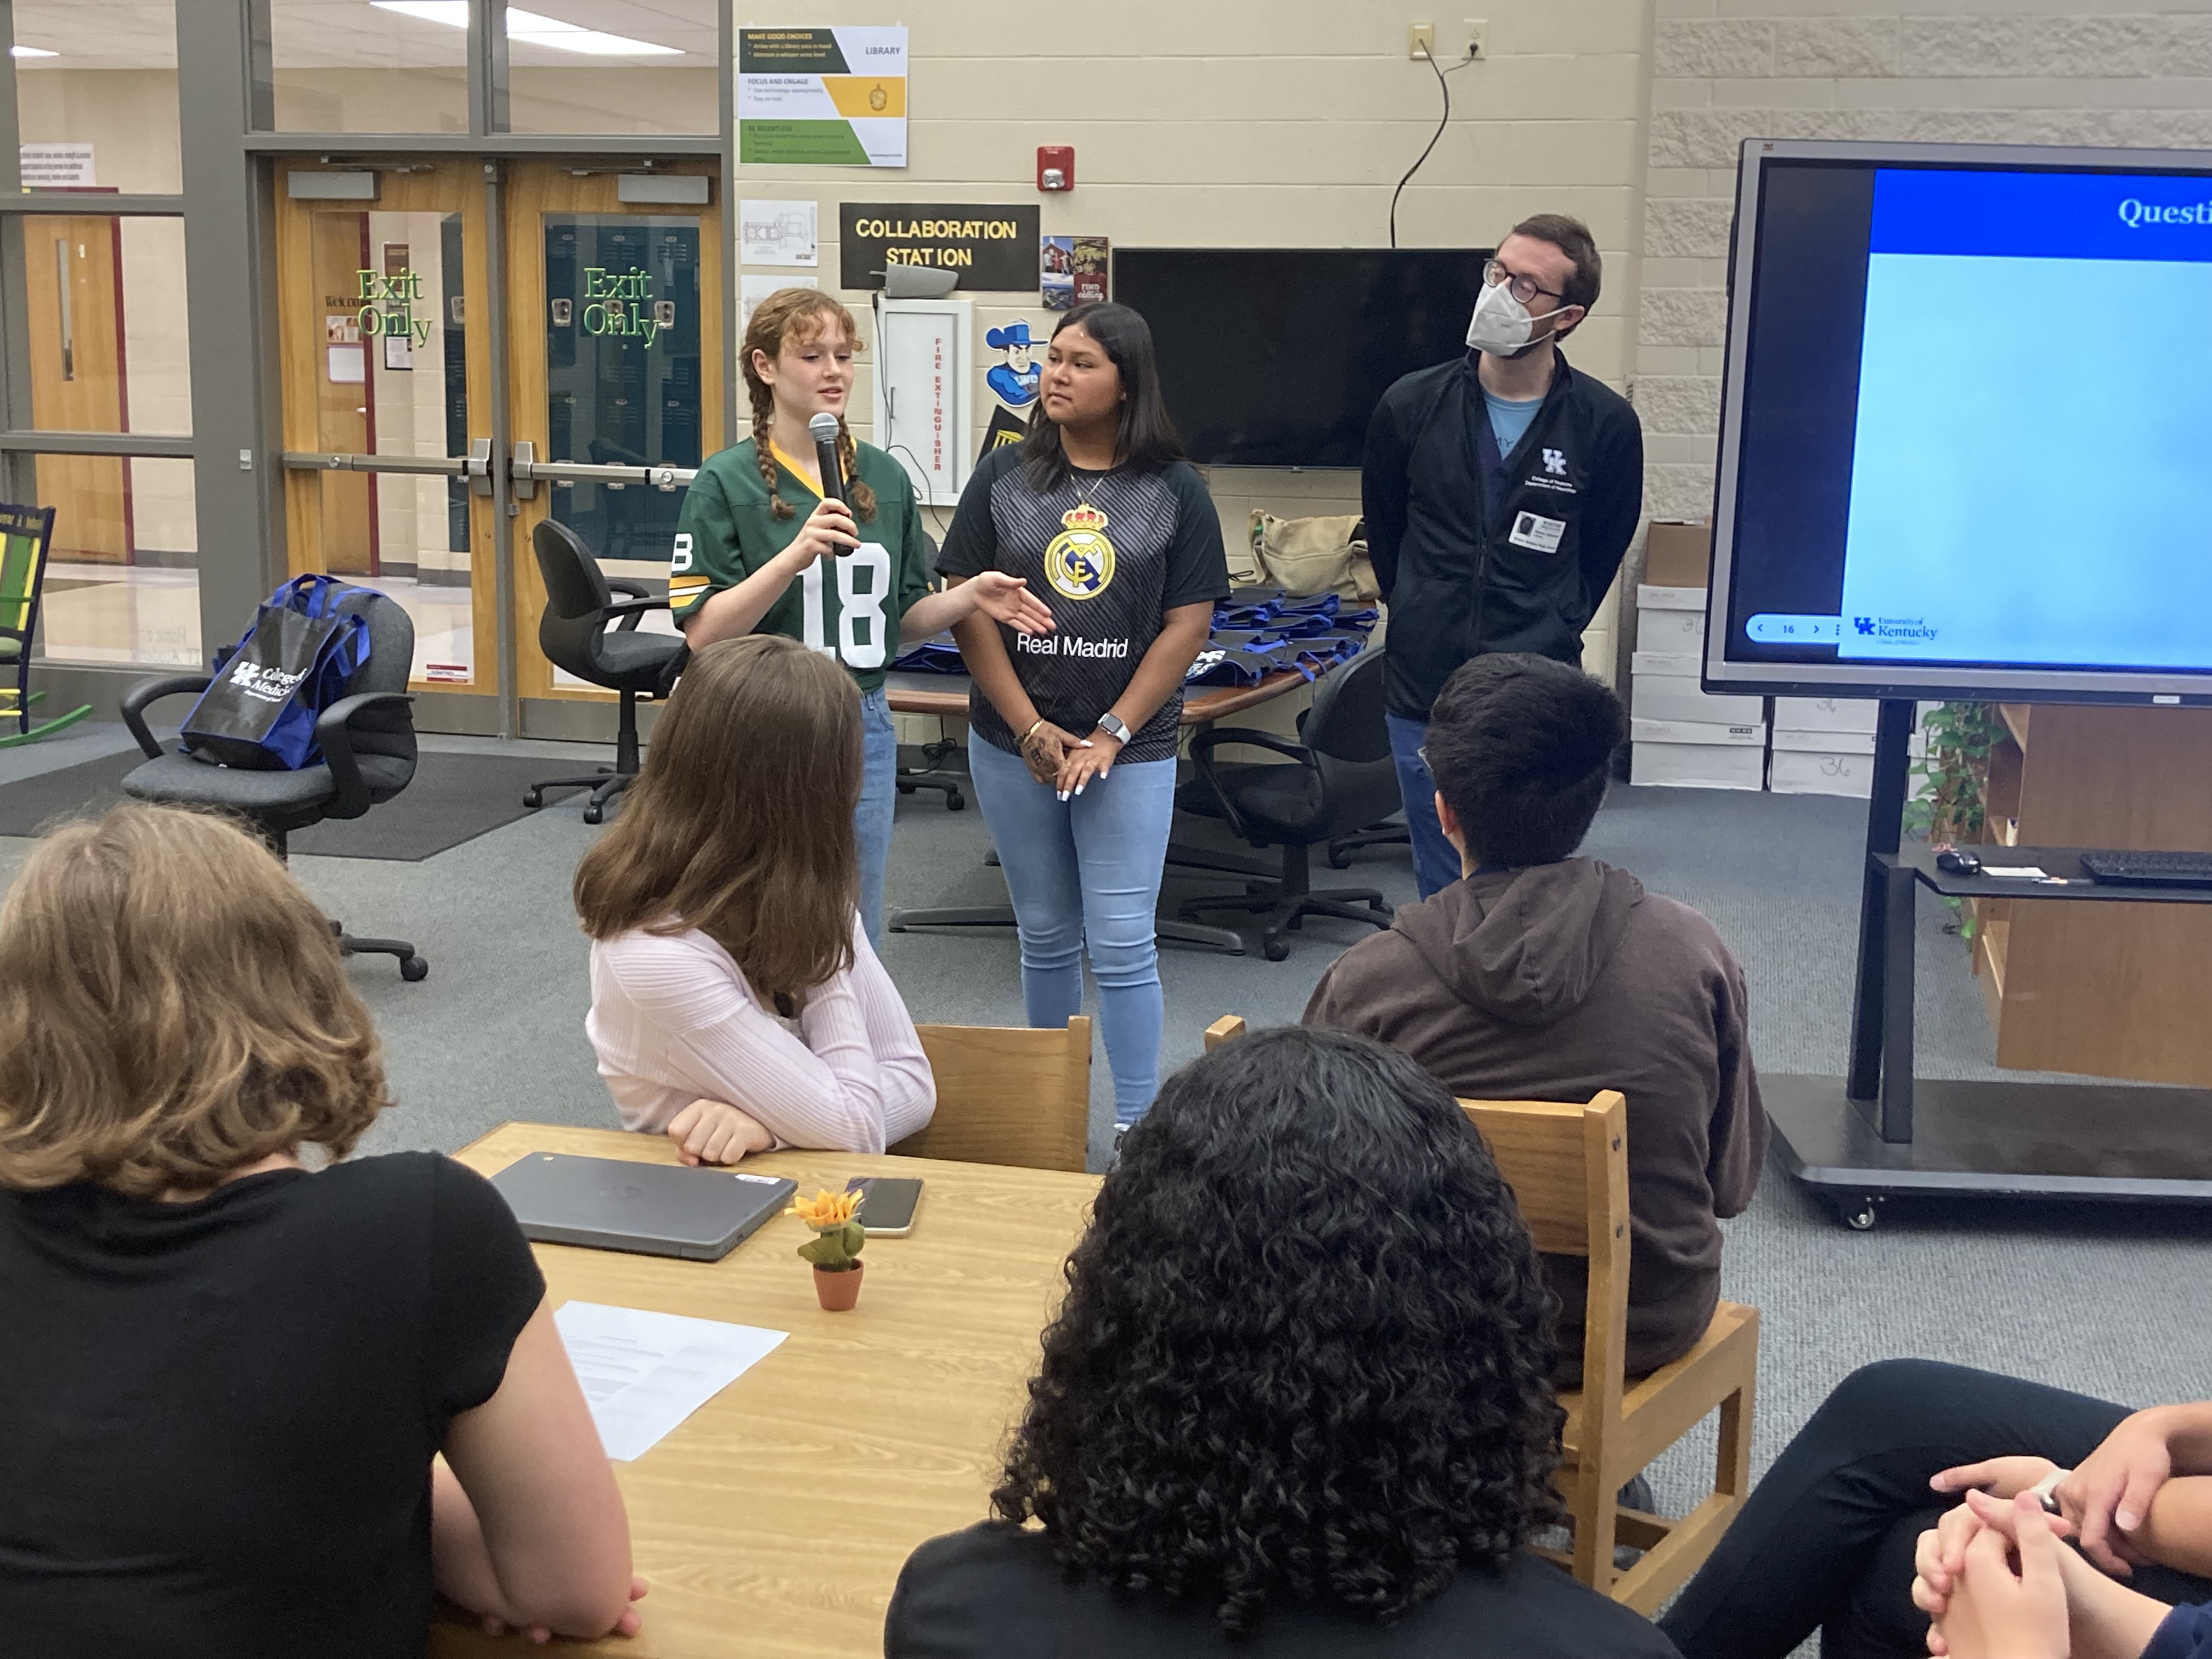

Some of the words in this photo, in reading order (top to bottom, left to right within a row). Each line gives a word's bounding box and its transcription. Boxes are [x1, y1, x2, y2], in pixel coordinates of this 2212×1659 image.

[866, 47, 901, 55] LIBRARY
[855, 218, 1017, 239] COLLABORATION
[885, 247, 972, 266] STATION
[356, 267, 424, 300] Exit
[584, 266, 653, 300] Exit
[1081, 283, 1100, 291] FIND
[358, 303, 433, 348] Only
[584, 303, 662, 348] Only
[934, 376, 942, 471] EXTINGUISHER
[1542, 448, 1567, 475] UK
[796, 542, 891, 668] 18
[1783, 624, 1795, 634] 16
[1854, 617, 1876, 635] UK
[1878, 617, 1914, 626] University
[1915, 617, 1925, 625] of
[1878, 625, 1938, 641] Kentucky
[1017, 632, 1058, 655] Real
[1063, 636, 1129, 658] Madrid
[1819, 757, 1850, 777] 36
